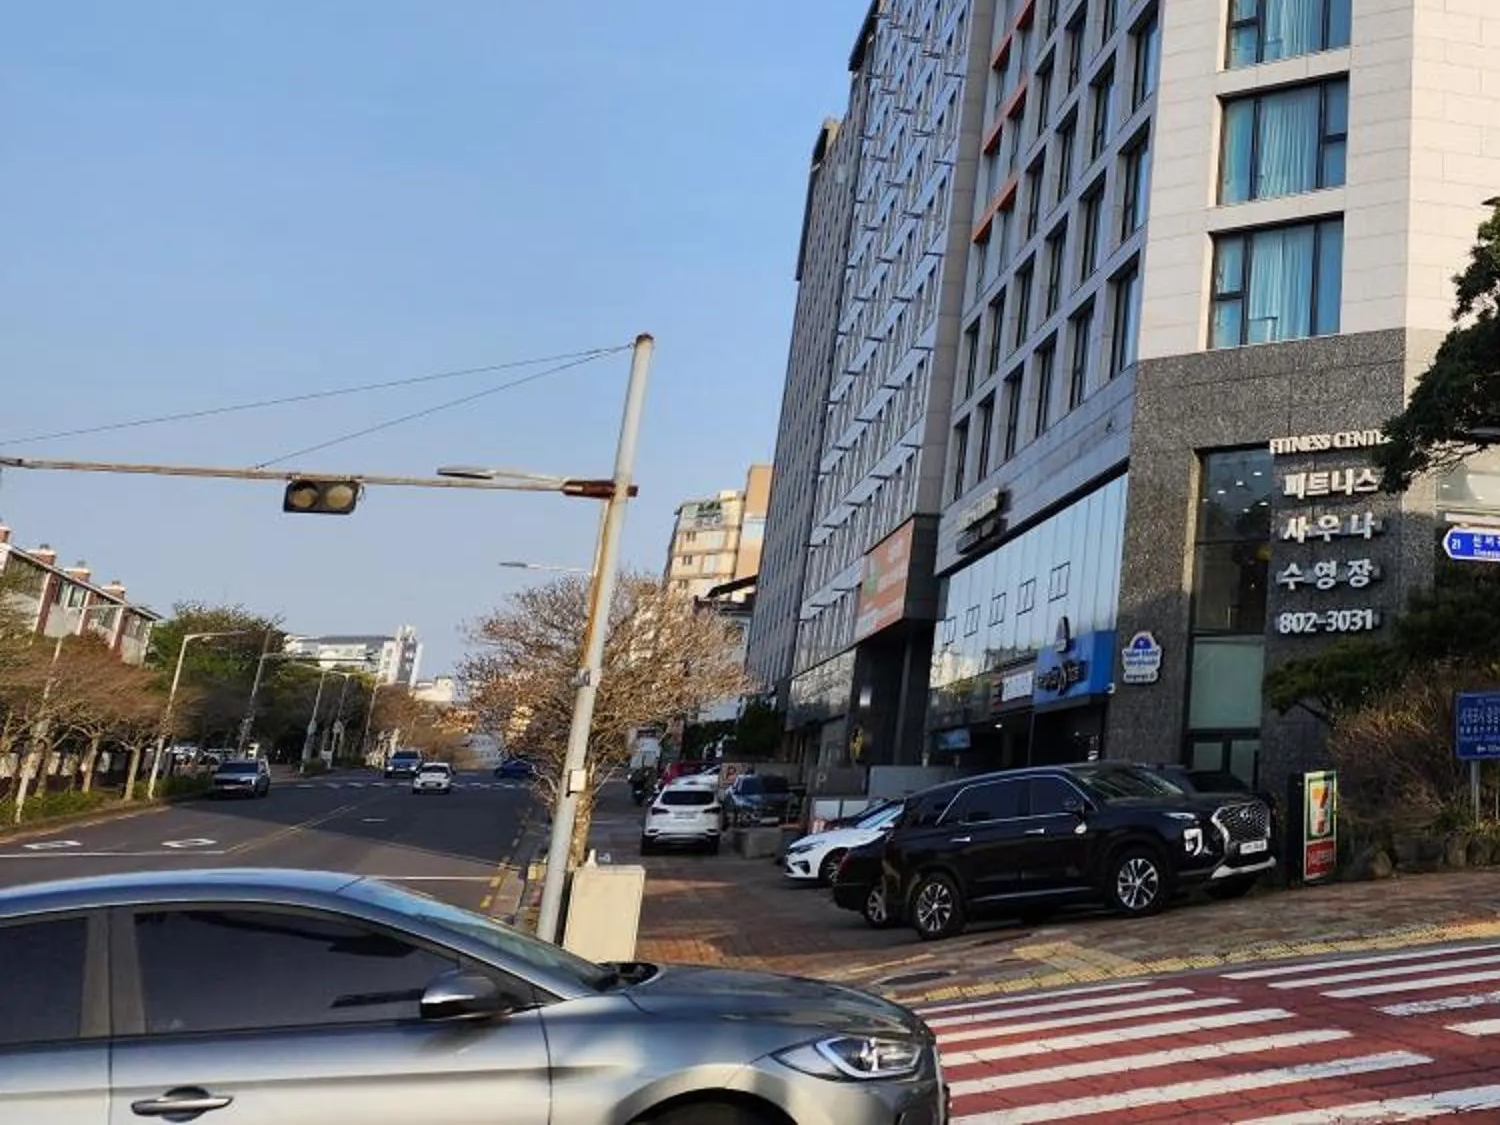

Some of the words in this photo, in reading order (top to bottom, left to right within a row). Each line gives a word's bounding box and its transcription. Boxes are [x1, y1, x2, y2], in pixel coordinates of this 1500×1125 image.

[1269, 435, 1331, 454] FITNESS
[1283, 511, 1377, 543] 사우나
[1282, 558, 1373, 590] 수영장
[1279, 609, 1374, 634] 802-3031
